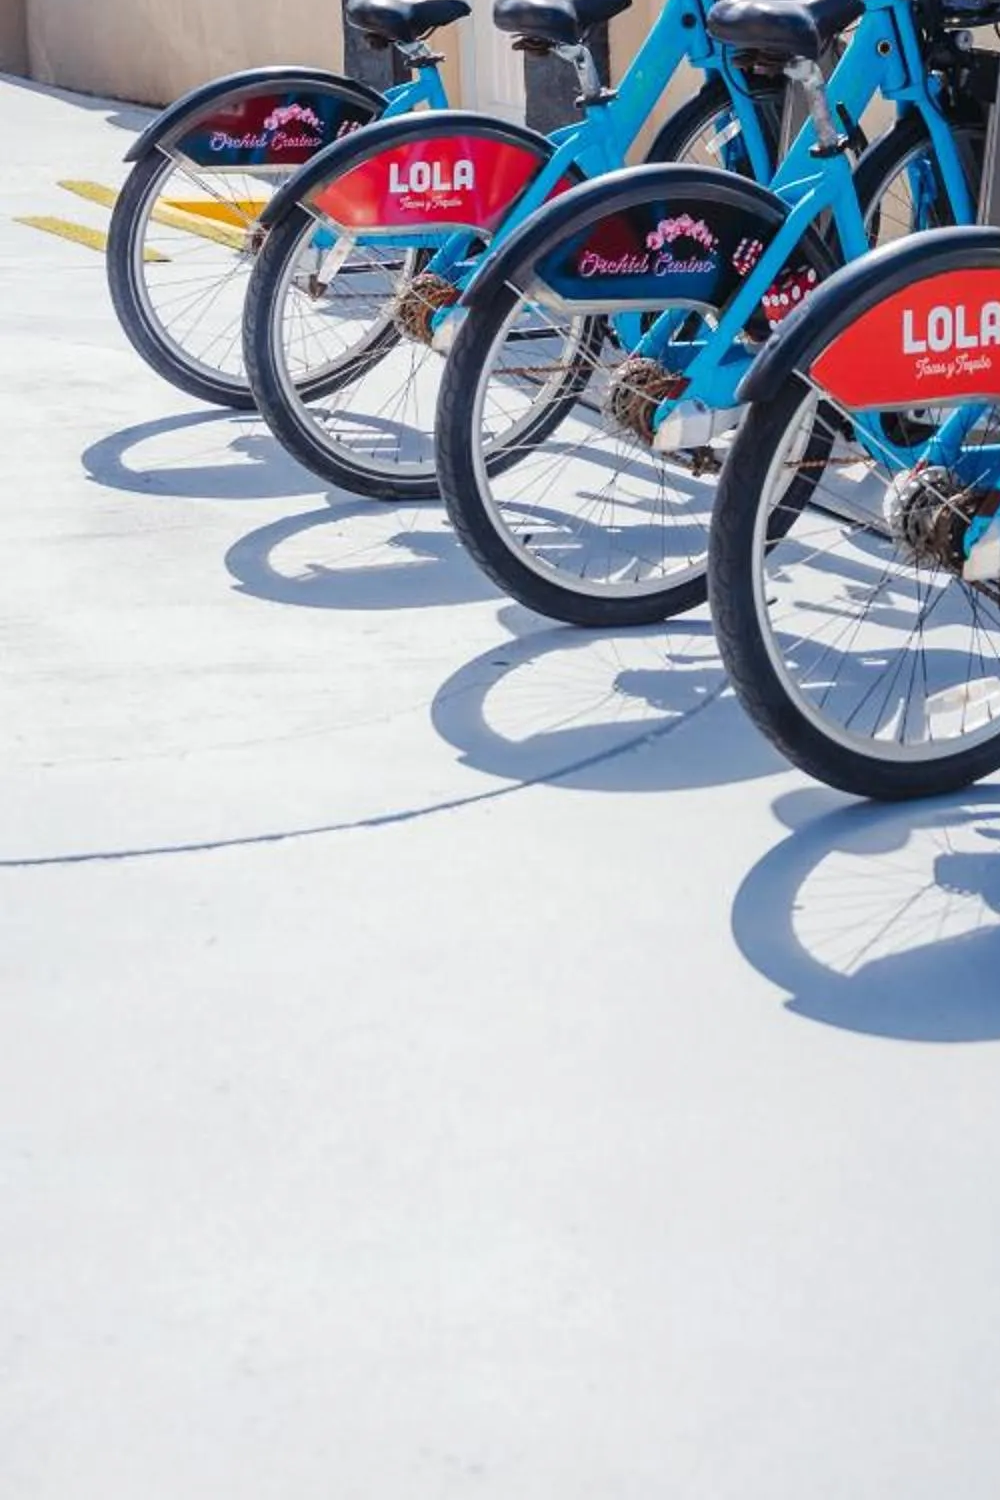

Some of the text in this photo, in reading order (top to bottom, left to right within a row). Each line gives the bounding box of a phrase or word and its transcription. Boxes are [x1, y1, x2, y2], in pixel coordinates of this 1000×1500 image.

[389, 159, 475, 193] LOLA
[579, 251, 716, 277] Orchid Casino
